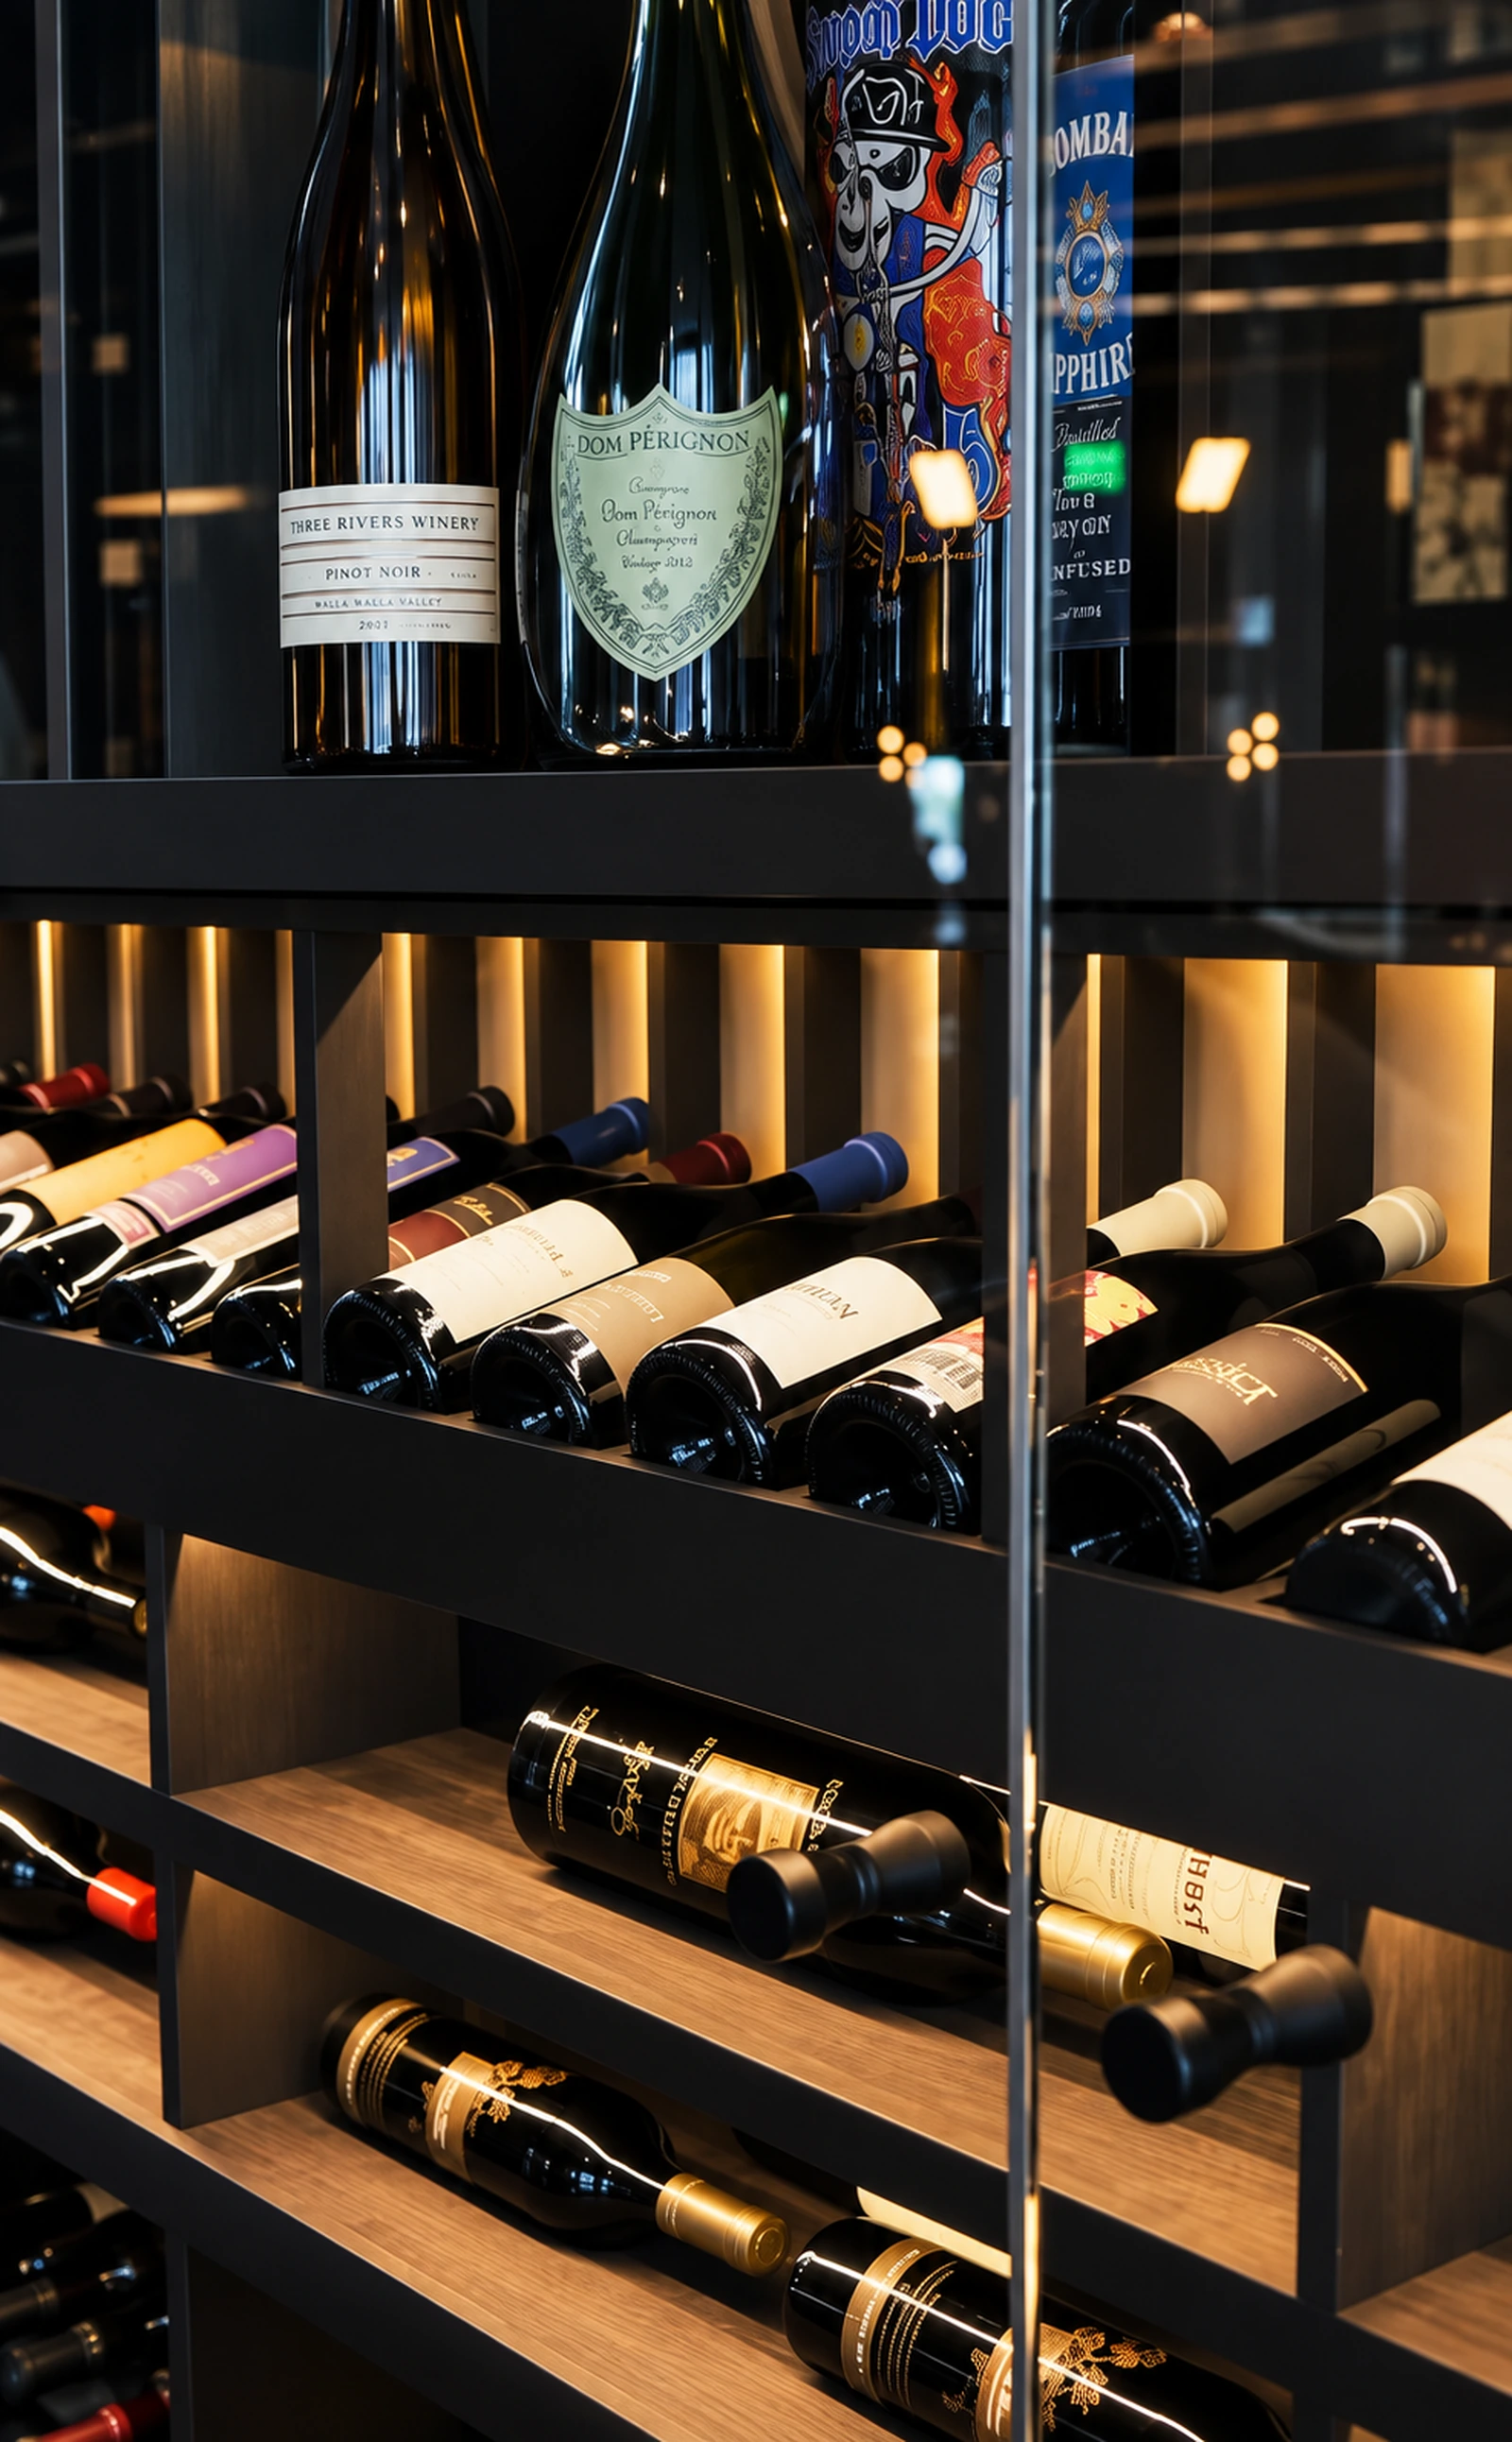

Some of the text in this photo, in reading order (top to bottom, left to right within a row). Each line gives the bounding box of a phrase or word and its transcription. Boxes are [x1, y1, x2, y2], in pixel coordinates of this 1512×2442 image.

[1051, 111, 1134, 172] OMBA
[1052, 333, 1135, 395] PPHIR
[577, 424, 750, 456] DOM PÉRIGNON
[291, 515, 480, 535] THREE RIVERS WINERY
[325, 566, 421, 580] PINOT NOIR
[1051, 558, 1132, 581] NFUSED
[400, 597, 442, 607] VALLEY
